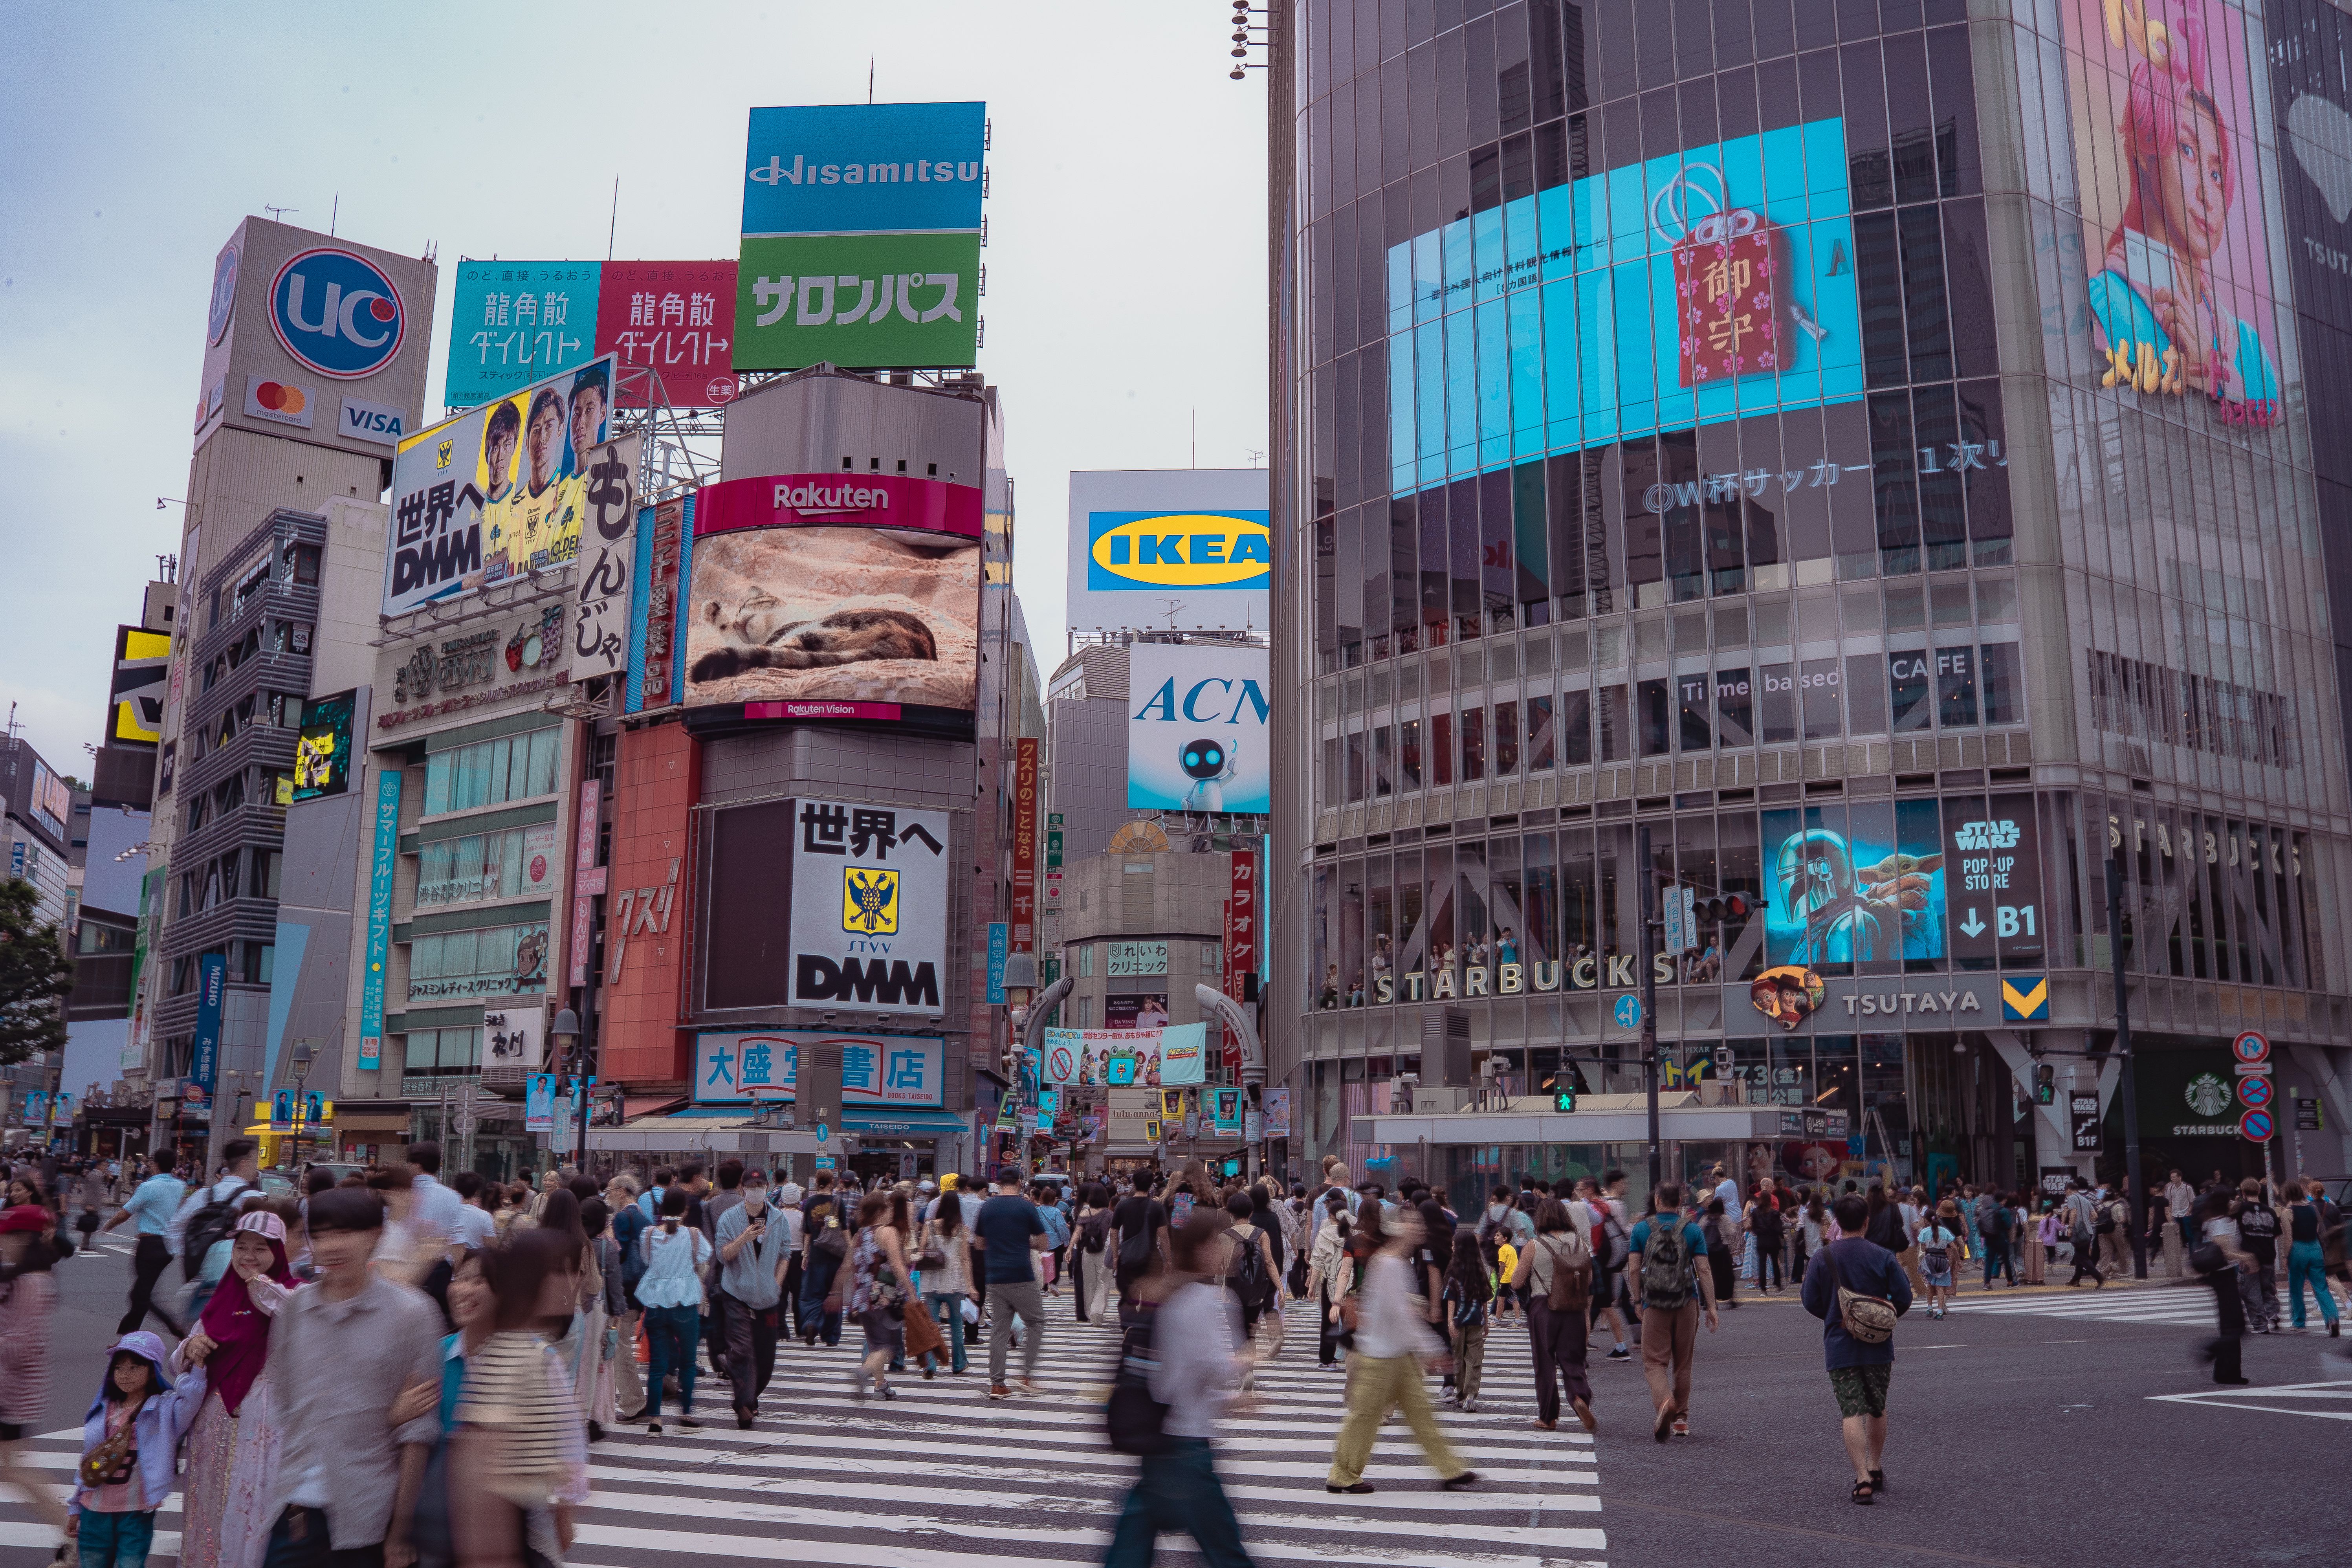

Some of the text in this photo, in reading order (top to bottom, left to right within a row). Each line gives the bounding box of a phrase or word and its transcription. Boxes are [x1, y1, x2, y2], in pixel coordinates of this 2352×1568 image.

[749, 155, 979, 185] Hisamitsu
[2303, 237, 2352, 276] TSUT
[467, 270, 591, 282] のど、直接、うるおう
[612, 270, 738, 282] のど、直接、うるおう
[484, 292, 569, 326] 龍角散
[630, 292, 715, 326] 龍角散
[752, 272, 962, 326] サロンパス
[1701, 257, 1754, 354] 御守
[469, 331, 581, 365] ダイレクト
[615, 331, 728, 365] ダイレクト
[480, 370, 523, 380] スティック
[526, 371, 544, 380] ミント
[708, 385, 733, 396] 生薬
[256, 408, 303, 424] mastercard
[344, 405, 402, 437] VISA
[774, 482, 888, 510] Rakuten
[397, 479, 486, 548] 世界へ
[391, 523, 482, 598] DMM
[575, 445, 632, 668] もんじゃ
[1110, 534, 1270, 565] IKEA
[1682, 654, 1966, 702] Time based CAFE
[788, 704, 854, 714] Rakuten Vision
[799, 802, 944, 860] 世界へ
[1013, 744, 1034, 942] クスリのことなら 三千里
[1955, 819, 2020, 838] STAR
[1955, 833, 2020, 851] WARS
[372, 802, 396, 956] サマーフルーツギフト
[1963, 855, 2015, 874] POP-UP
[1965, 872, 2010, 890] STORE
[1233, 864, 1252, 958] カラオケ
[1671, 891, 1681, 949] 渋谷駅前
[1685, 891, 1695, 945] スクランブル式
[1996, 904, 2036, 937] B1
[991, 928, 1004, 1000] 大盛堂商事ビル
[1110, 961, 1167, 974] クリニック
[1124, 944, 1167, 958] れいわ
[208, 965, 221, 1007] MIZUHO
[795, 954, 940, 1007] DMM
[1377, 952, 1675, 1004] STARBUCKS
[1842, 991, 1982, 1016] TSUTAYA
[199, 1037, 212, 1082] みずほ銀行
[1657, 1046, 1681, 1056] Disney
[2077, 1135, 2097, 1146] B1F
[2042, 1174, 2074, 1183] STAR
[2043, 1182, 2066, 1190] WAR
